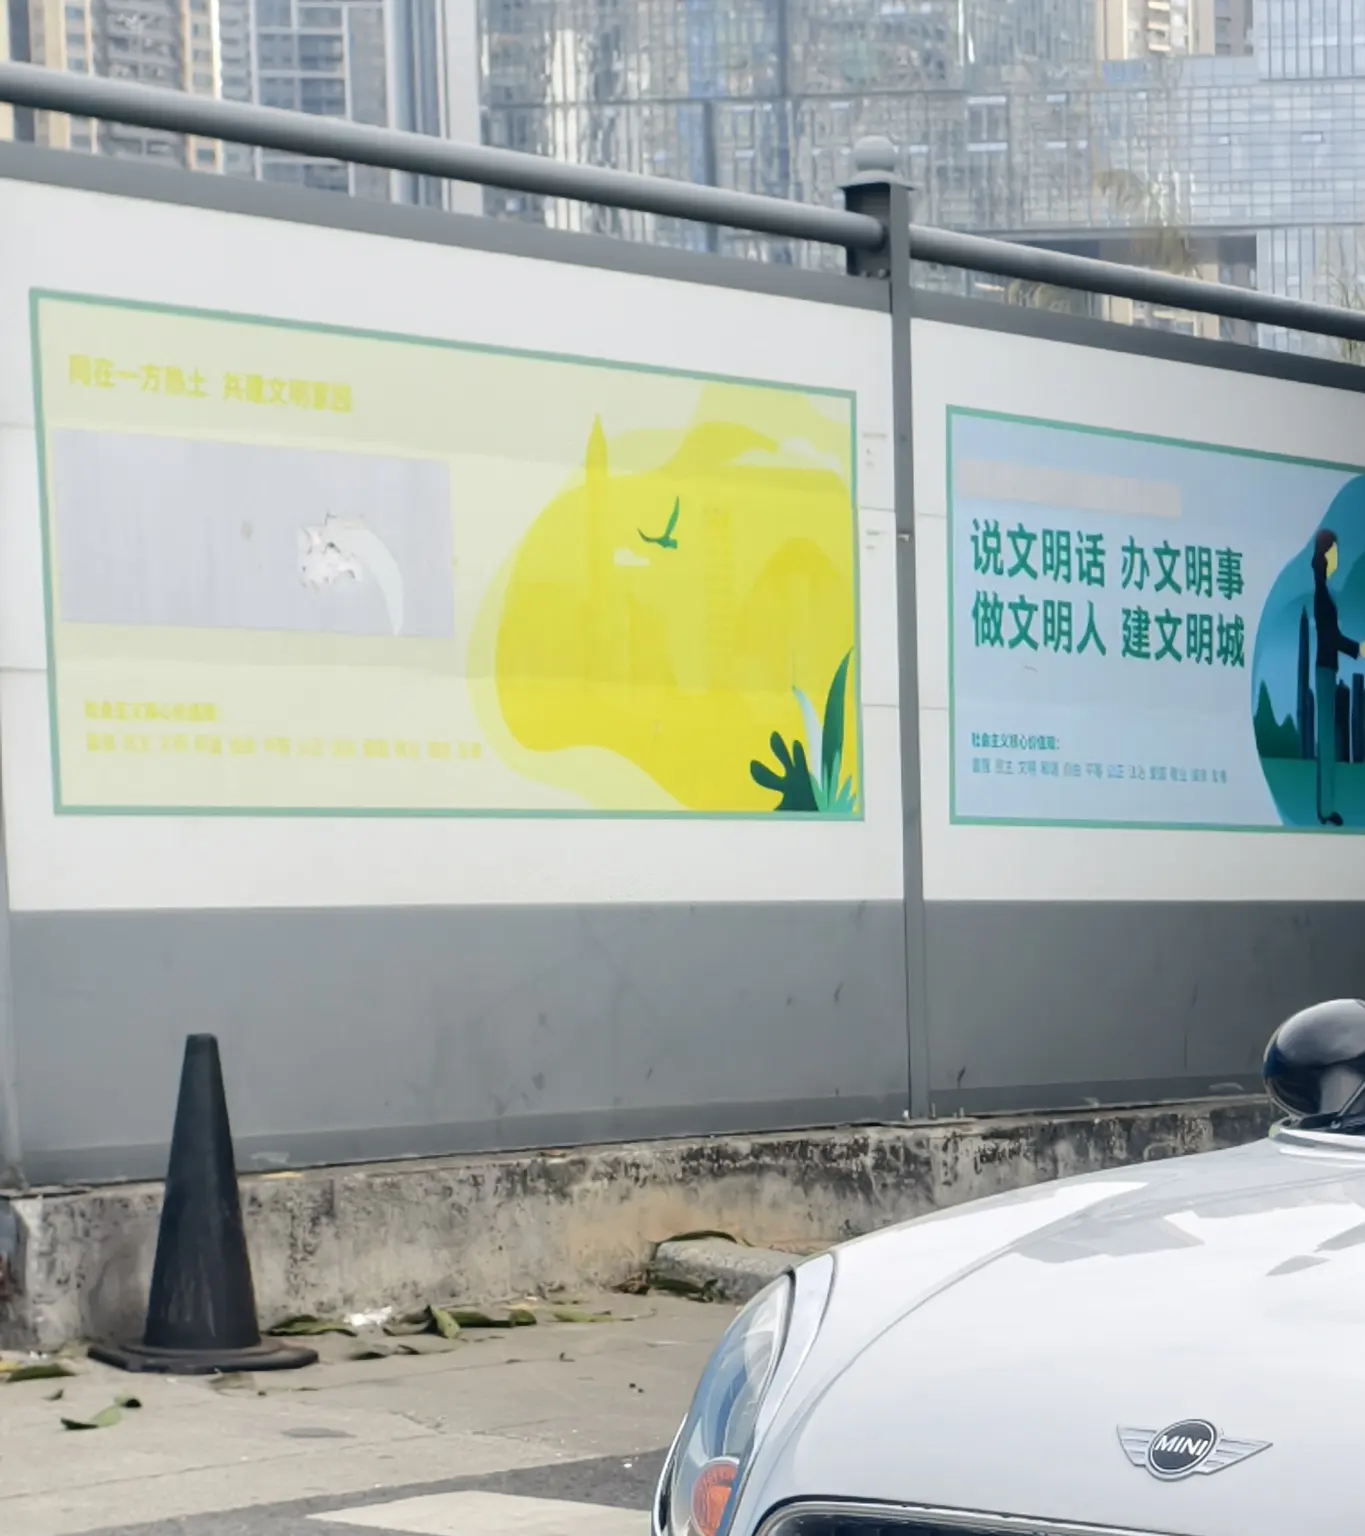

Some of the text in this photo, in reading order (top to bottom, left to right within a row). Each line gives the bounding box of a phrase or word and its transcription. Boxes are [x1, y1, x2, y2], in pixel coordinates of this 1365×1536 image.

[971, 518, 1244, 600] 说文明话 办文明事
[971, 590, 1244, 668] 做文明人 建文明城
[1155, 1435, 1208, 1456] MINI
